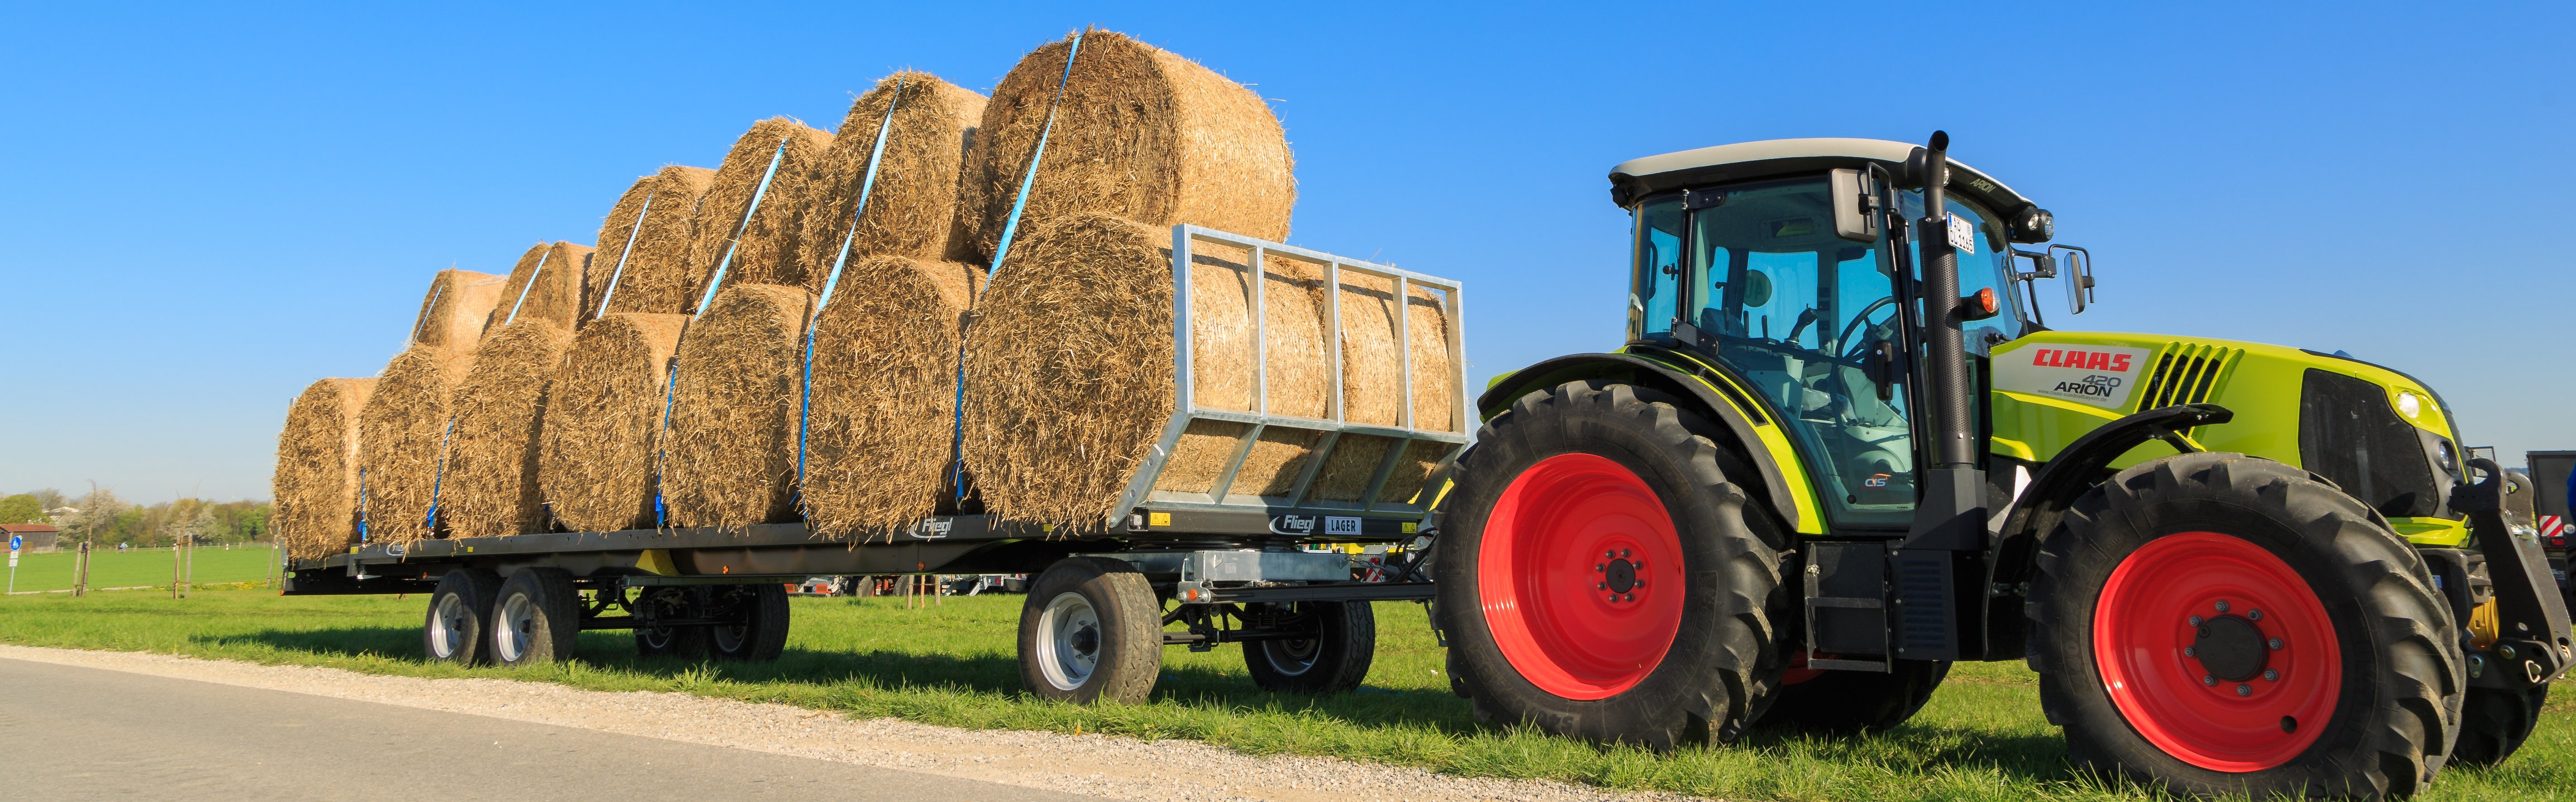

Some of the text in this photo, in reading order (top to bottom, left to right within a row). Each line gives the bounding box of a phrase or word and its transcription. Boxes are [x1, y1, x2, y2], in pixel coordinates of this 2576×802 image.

[1969, 178, 1996, 193] ARION
[1959, 234, 1973, 252] 1165
[2033, 349, 2132, 372] CLAAS
[2082, 375, 2122, 387] 420
[2037, 388, 2107, 402] www.claas-suedostbayern.de
[2053, 382, 2112, 397] ARION
[1865, 478, 1886, 487] CIS
[922, 517, 953, 535] Fliegl
[1283, 515, 1316, 533] Fliegl
[1331, 520, 1356, 532] LAGER
